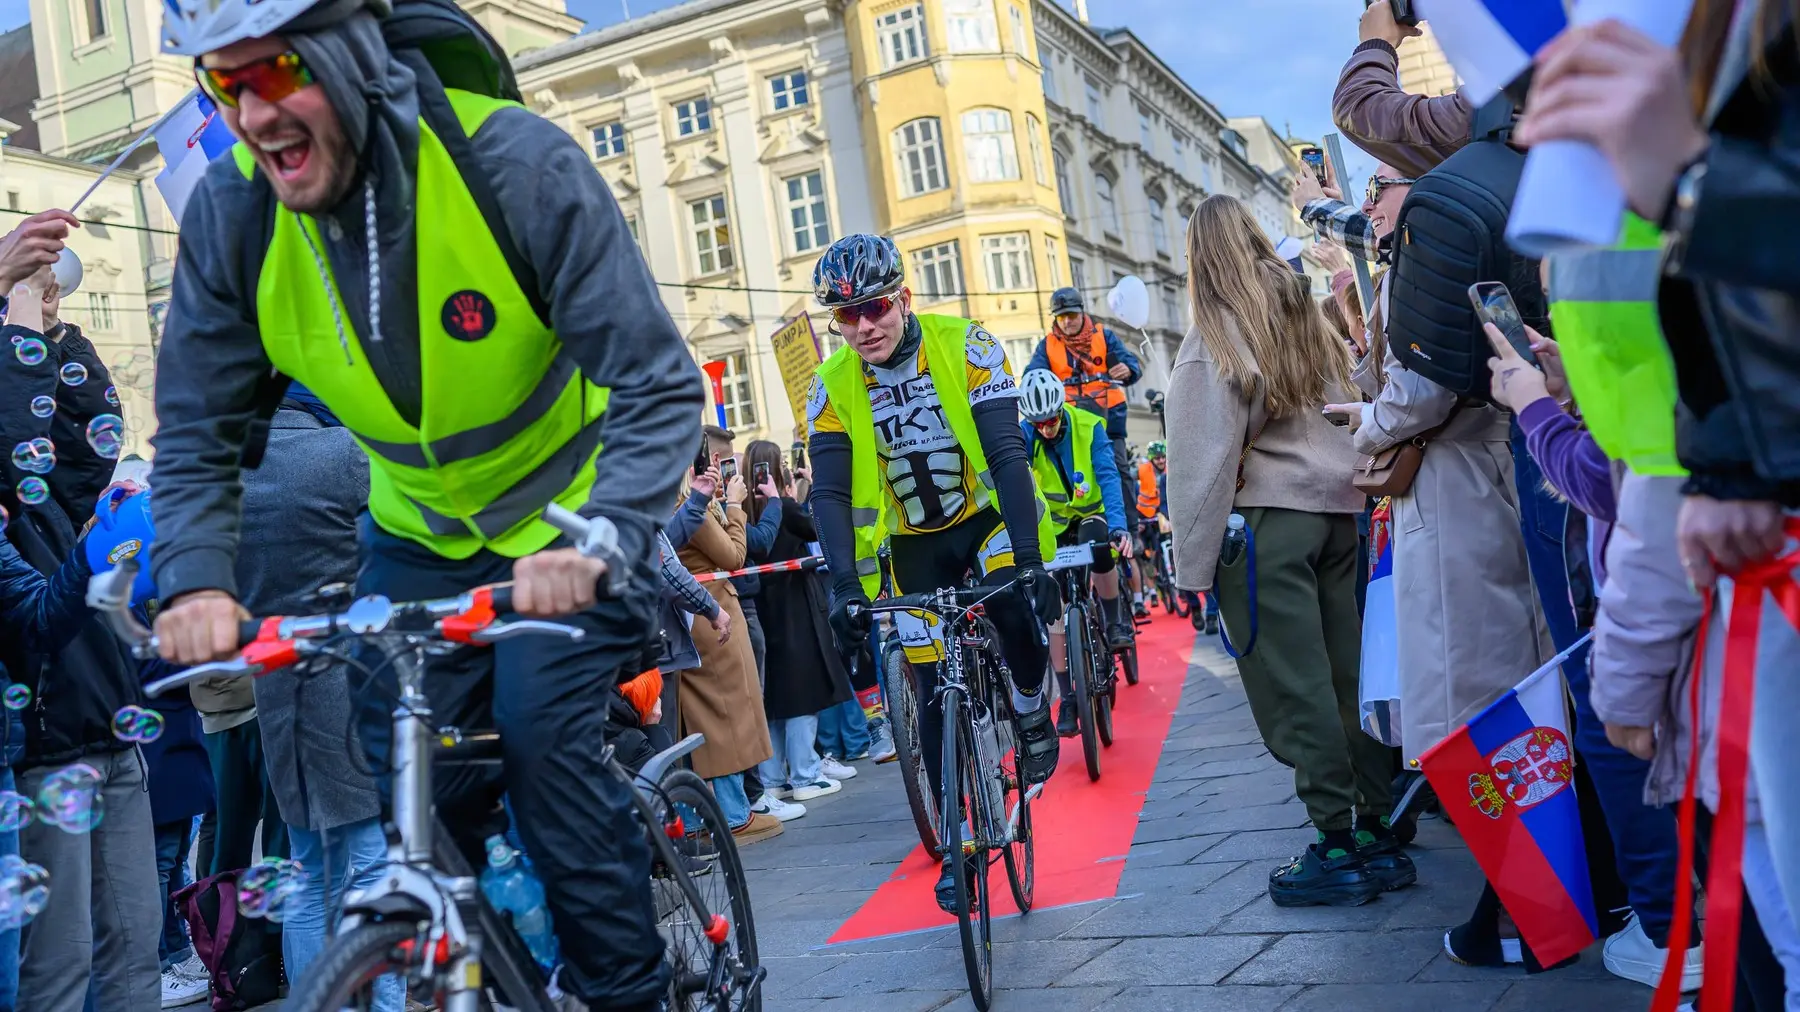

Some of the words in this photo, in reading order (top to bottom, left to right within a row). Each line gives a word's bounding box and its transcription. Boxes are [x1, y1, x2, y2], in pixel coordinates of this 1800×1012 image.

[774, 318, 808, 354] PUMPAJ
[982, 378, 1016, 396] Peda
[954, 635, 965, 684] FOCUS
